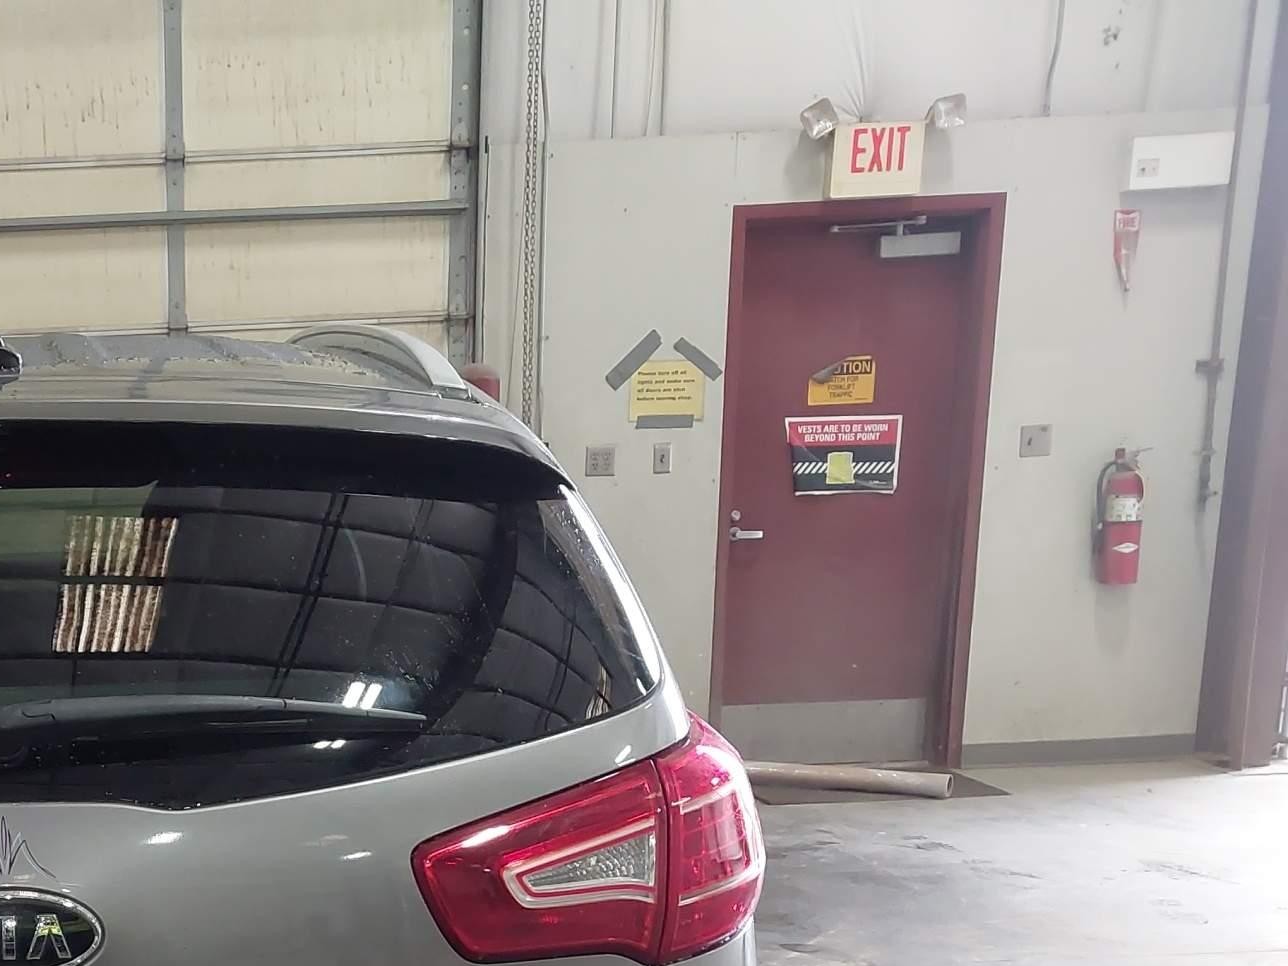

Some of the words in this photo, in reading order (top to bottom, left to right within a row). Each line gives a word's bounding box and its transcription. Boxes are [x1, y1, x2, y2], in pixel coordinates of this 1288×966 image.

[850, 126, 911, 174] EXIT
[797, 424, 824, 434] VESTS
[823, 424, 839, 433] ARE
[841, 424, 851, 433] TO
[852, 423, 863, 433] BE
[864, 423, 889, 432] WORN
[804, 433, 836, 443] BEYOND
[837, 433, 855, 442] THIS
[856, 432, 881, 441] POINT
